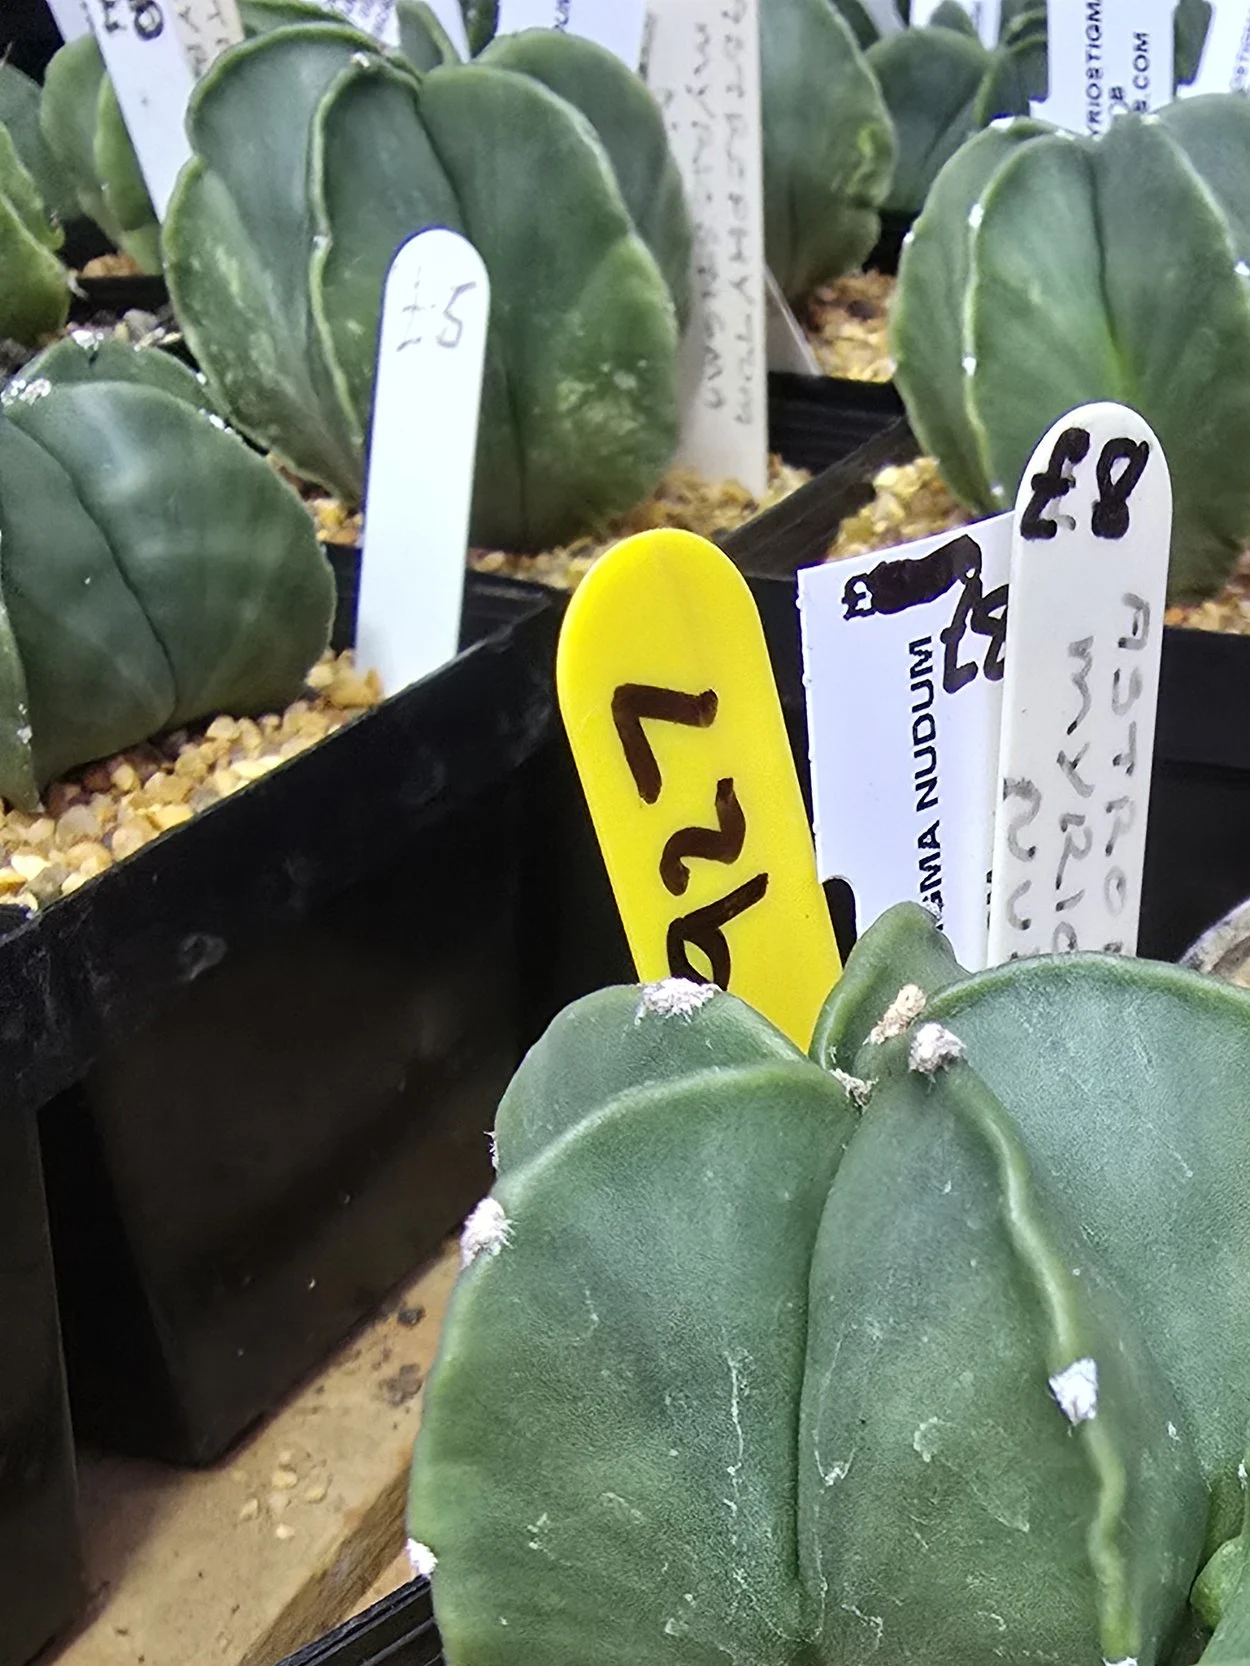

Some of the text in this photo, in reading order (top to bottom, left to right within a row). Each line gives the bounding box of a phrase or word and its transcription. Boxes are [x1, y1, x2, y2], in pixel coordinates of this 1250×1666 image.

[1085, 0, 1103, 136] YRIOSTIGM
[1020, 427, 1150, 540] £8
[907, 635, 938, 812] NUDUM
